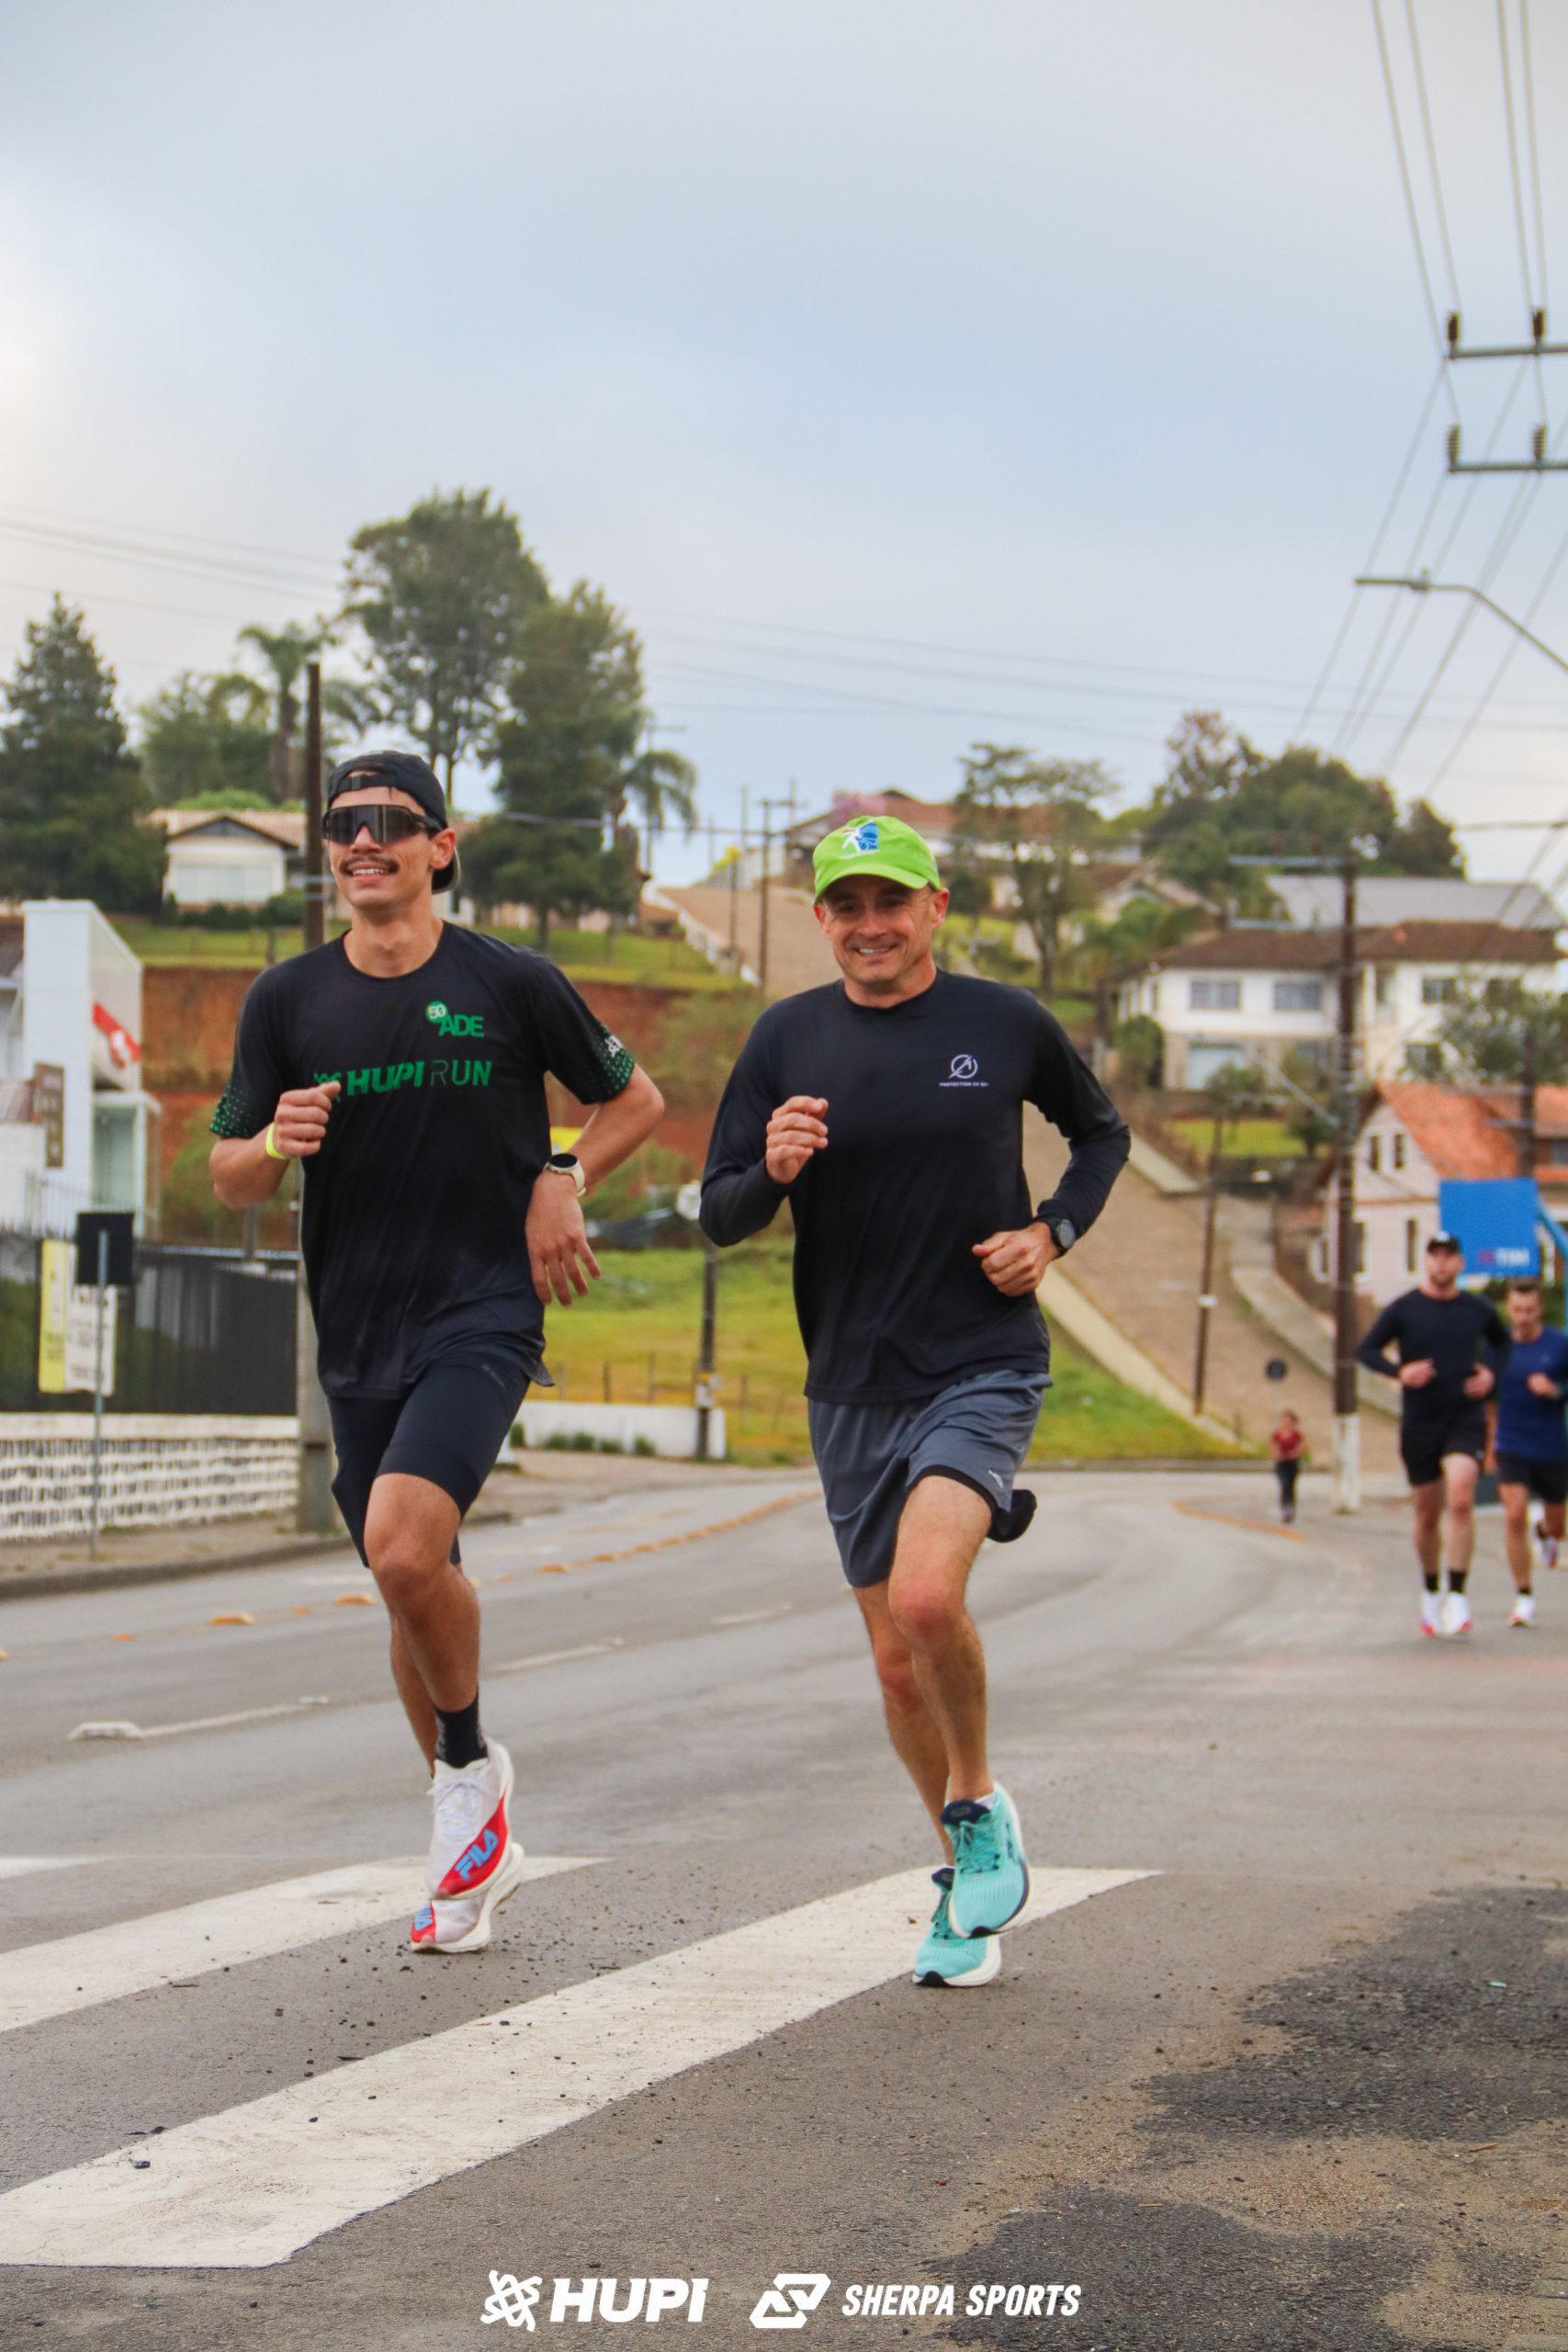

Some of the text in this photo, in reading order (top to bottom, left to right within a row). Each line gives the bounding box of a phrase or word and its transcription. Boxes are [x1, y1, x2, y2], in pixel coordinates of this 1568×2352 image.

[438, 1014, 484, 1037] ADE
[346, 1058, 492, 1096] HUPI RUN
[455, 1828, 499, 1882] FILA
